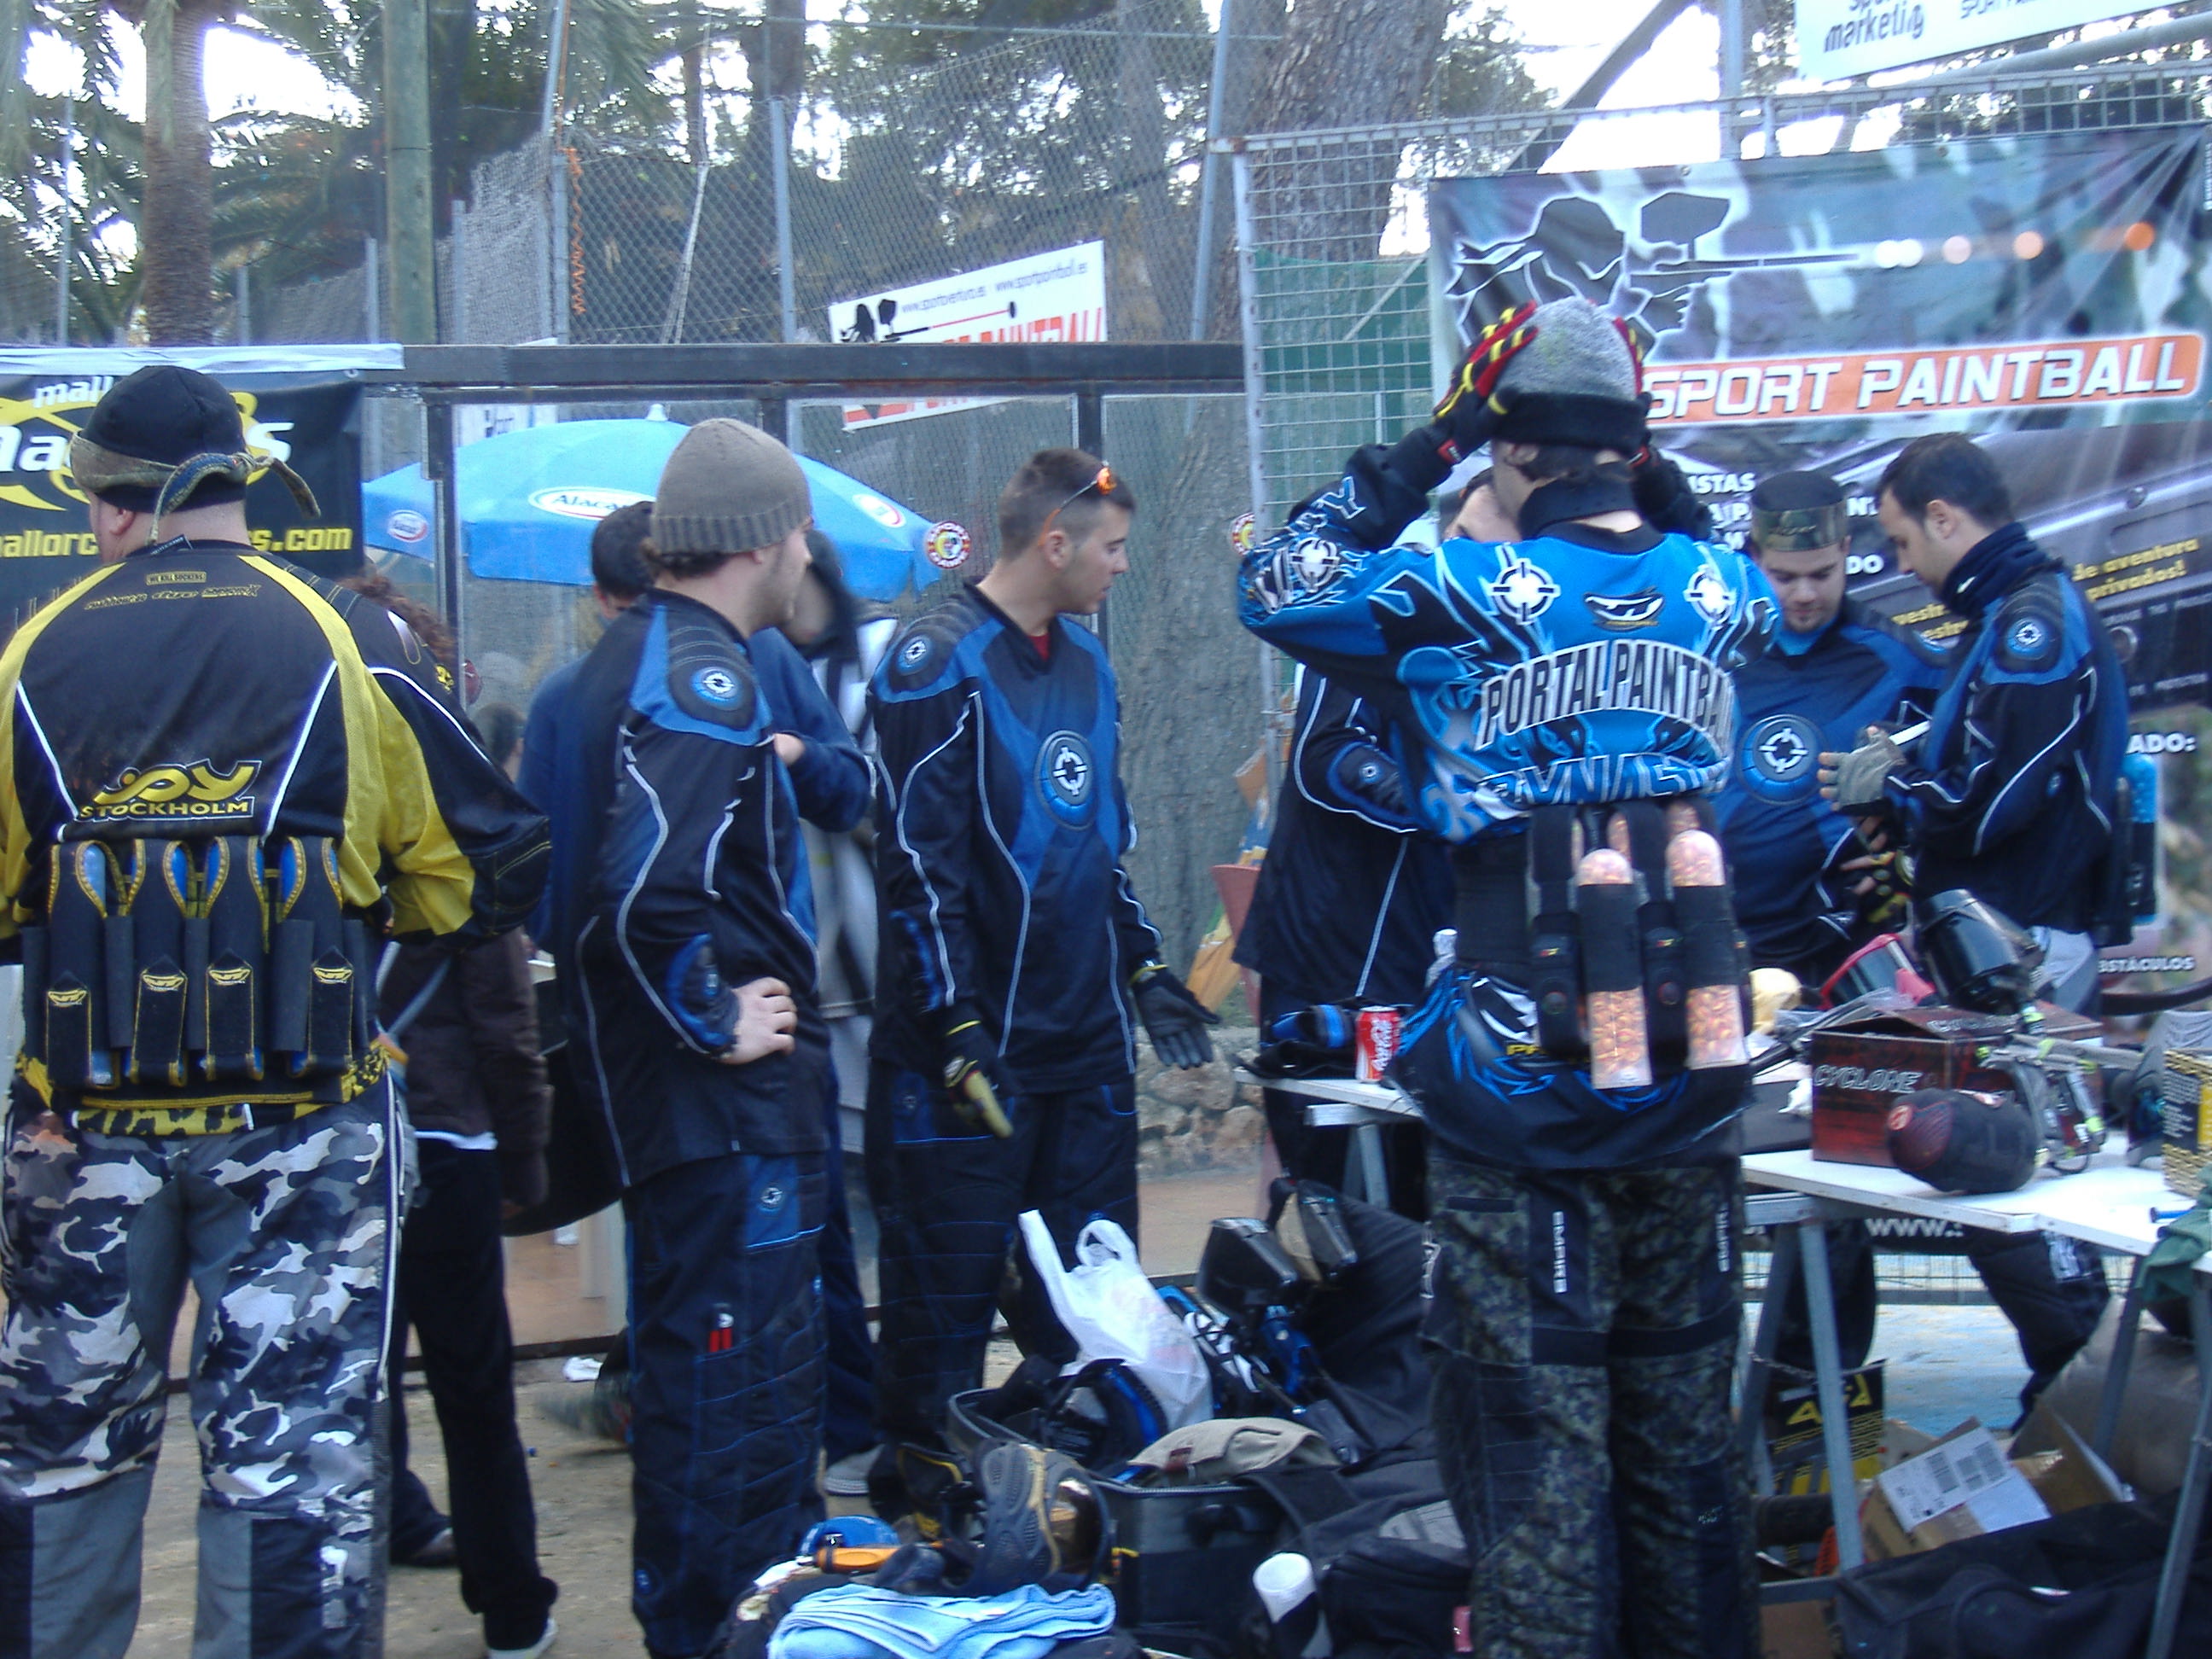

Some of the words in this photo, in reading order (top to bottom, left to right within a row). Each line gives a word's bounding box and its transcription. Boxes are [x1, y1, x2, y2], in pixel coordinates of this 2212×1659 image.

[1642, 362, 1841, 420] SPORT
[1856, 342, 2186, 409] PAINTBALL
[2102, 538, 2200, 573] aventura
[2085, 558, 2187, 603] privados!
[80, 800, 249, 818] STOCKHOLM
